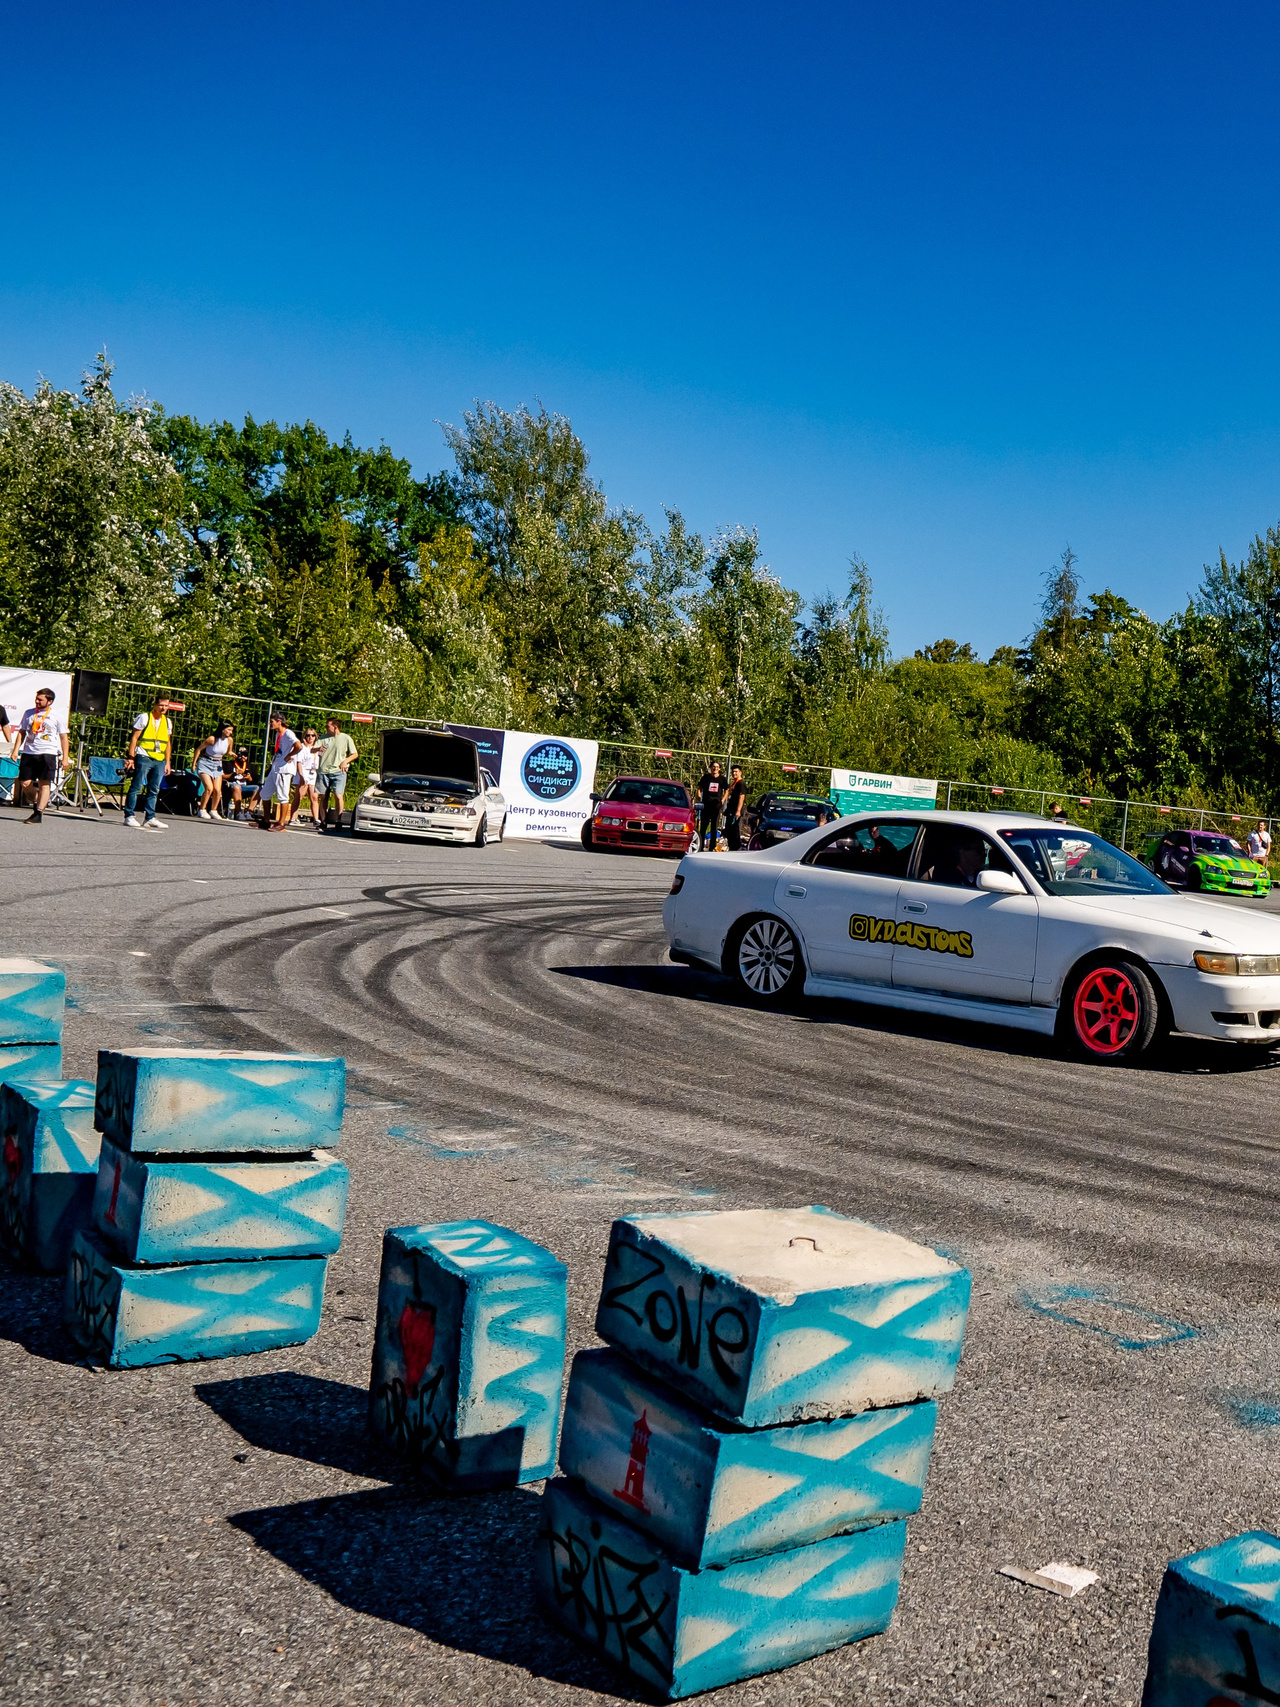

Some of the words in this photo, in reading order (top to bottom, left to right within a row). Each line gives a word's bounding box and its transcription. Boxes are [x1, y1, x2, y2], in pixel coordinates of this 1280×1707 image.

[857, 777, 893, 789] ГАРВИН
[506, 804, 536, 816] Центр
[538, 808, 587, 819] кузовного
